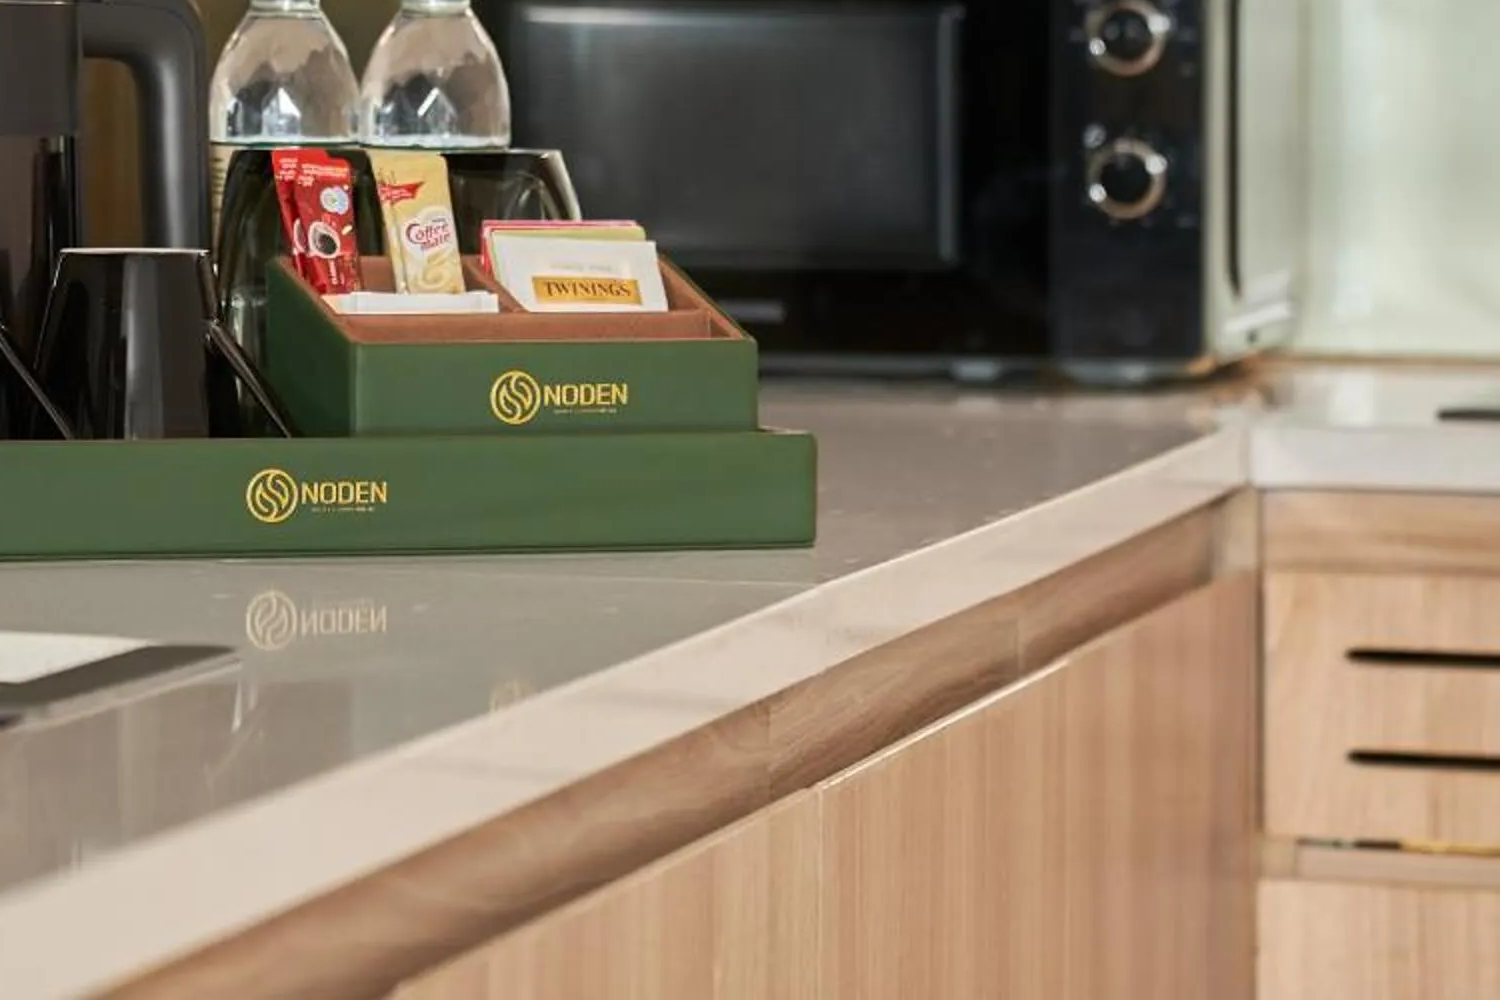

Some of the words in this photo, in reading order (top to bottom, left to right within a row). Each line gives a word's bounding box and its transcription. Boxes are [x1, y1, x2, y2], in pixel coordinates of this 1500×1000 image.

[405, 222, 449, 245] Coffee
[543, 383, 628, 407] NODEN
[301, 481, 387, 505] NODEN
